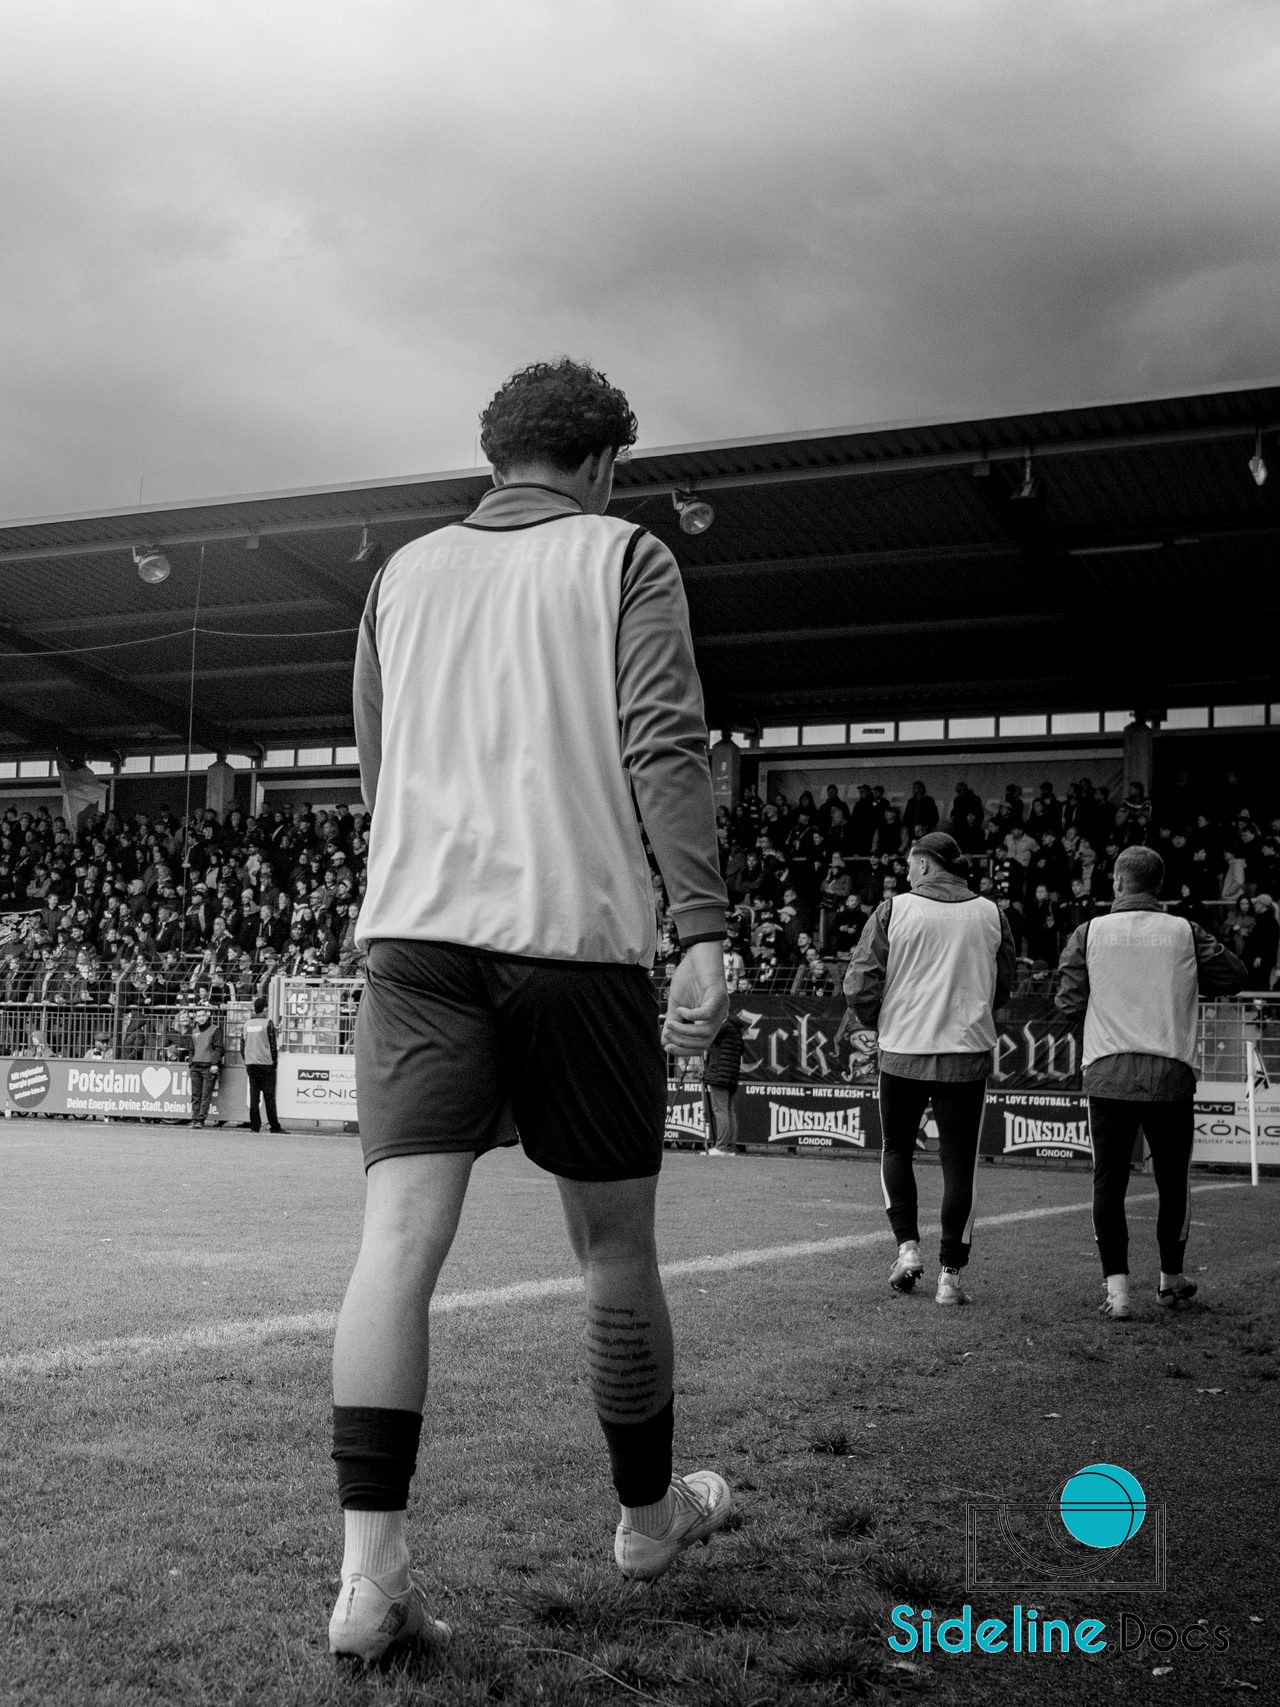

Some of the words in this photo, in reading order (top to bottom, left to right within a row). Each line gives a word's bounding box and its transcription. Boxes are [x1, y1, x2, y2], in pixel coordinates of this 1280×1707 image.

[68, 1068, 141, 1093] Potsdam
[300, 1071, 329, 1079] AUTO
[746, 1086, 766, 1095] LOVE
[767, 1087, 805, 1097] FOOTBALL
[812, 1088, 832, 1098] HATE
[834, 1089, 864, 1099] RACISM
[67, 1097, 87, 1108] Deine
[119, 1099, 141, 1110] Deine
[1005, 1096, 1027, 1105] LOVE
[1028, 1097, 1071, 1107] FOOTBALL
[798, 1136, 832, 1147] LONDON
[1036, 1148, 1073, 1159] LONDON
